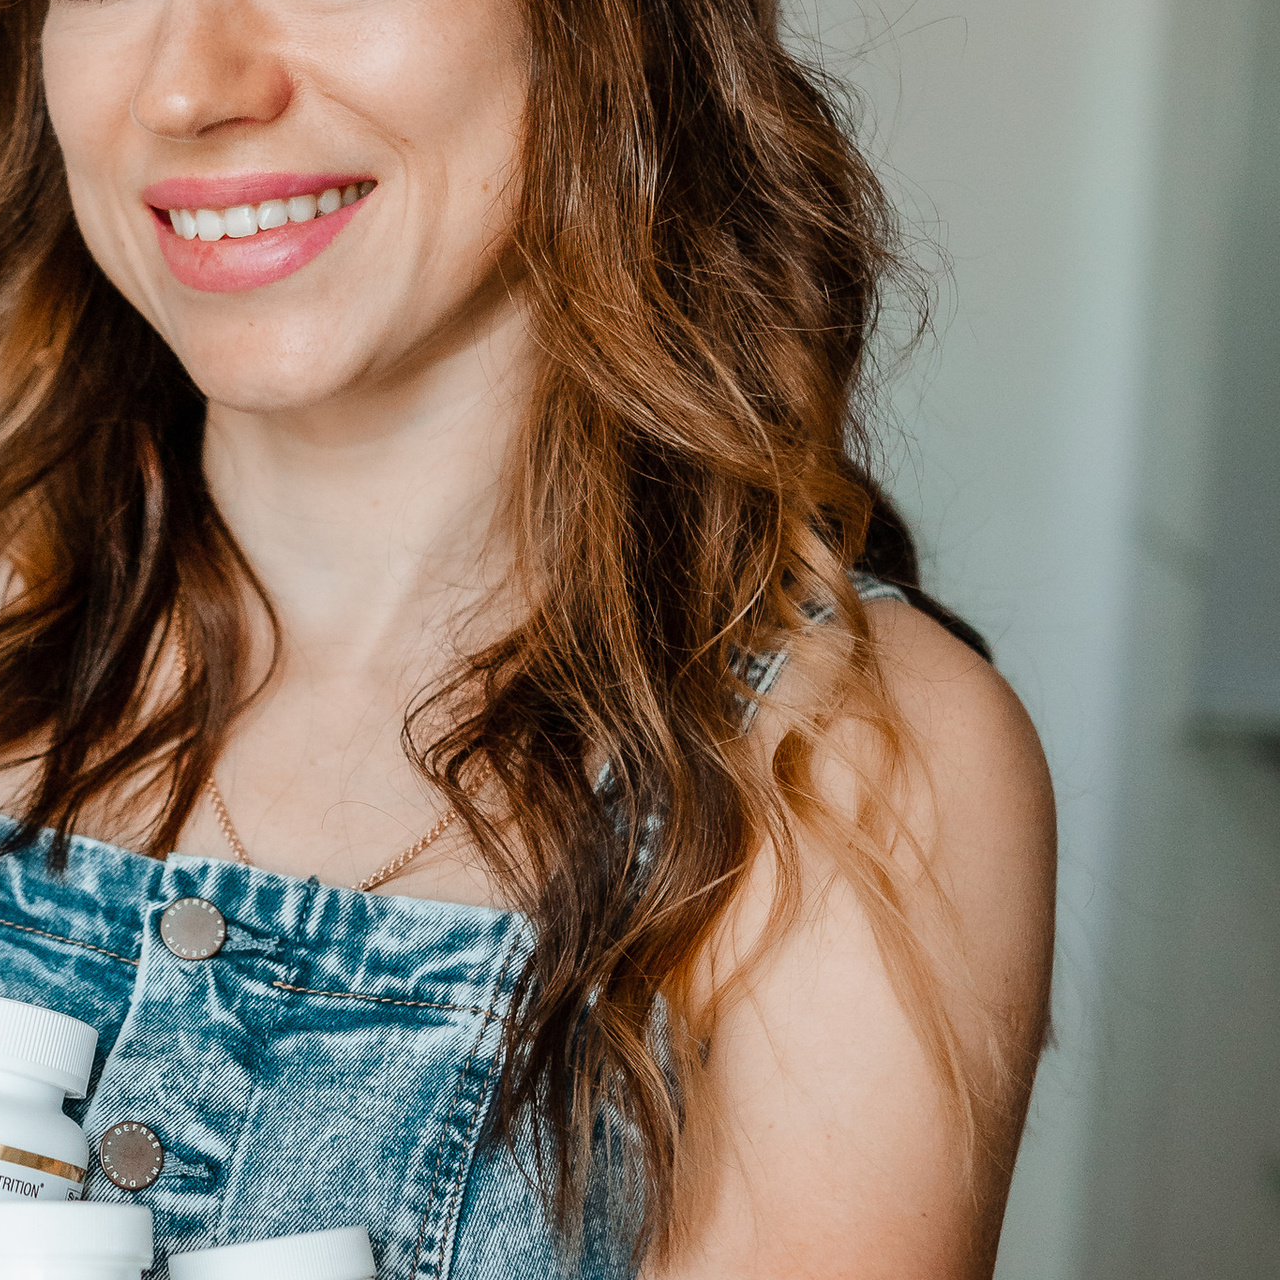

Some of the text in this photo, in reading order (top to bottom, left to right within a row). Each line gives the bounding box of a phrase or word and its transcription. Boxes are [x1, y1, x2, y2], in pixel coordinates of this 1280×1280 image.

[167, 898, 217, 917] BEFREE
[166, 936, 208, 958] DENIM
[113, 1123, 160, 1149] BEFREE
[103, 1154, 137, 1188] DENIM
